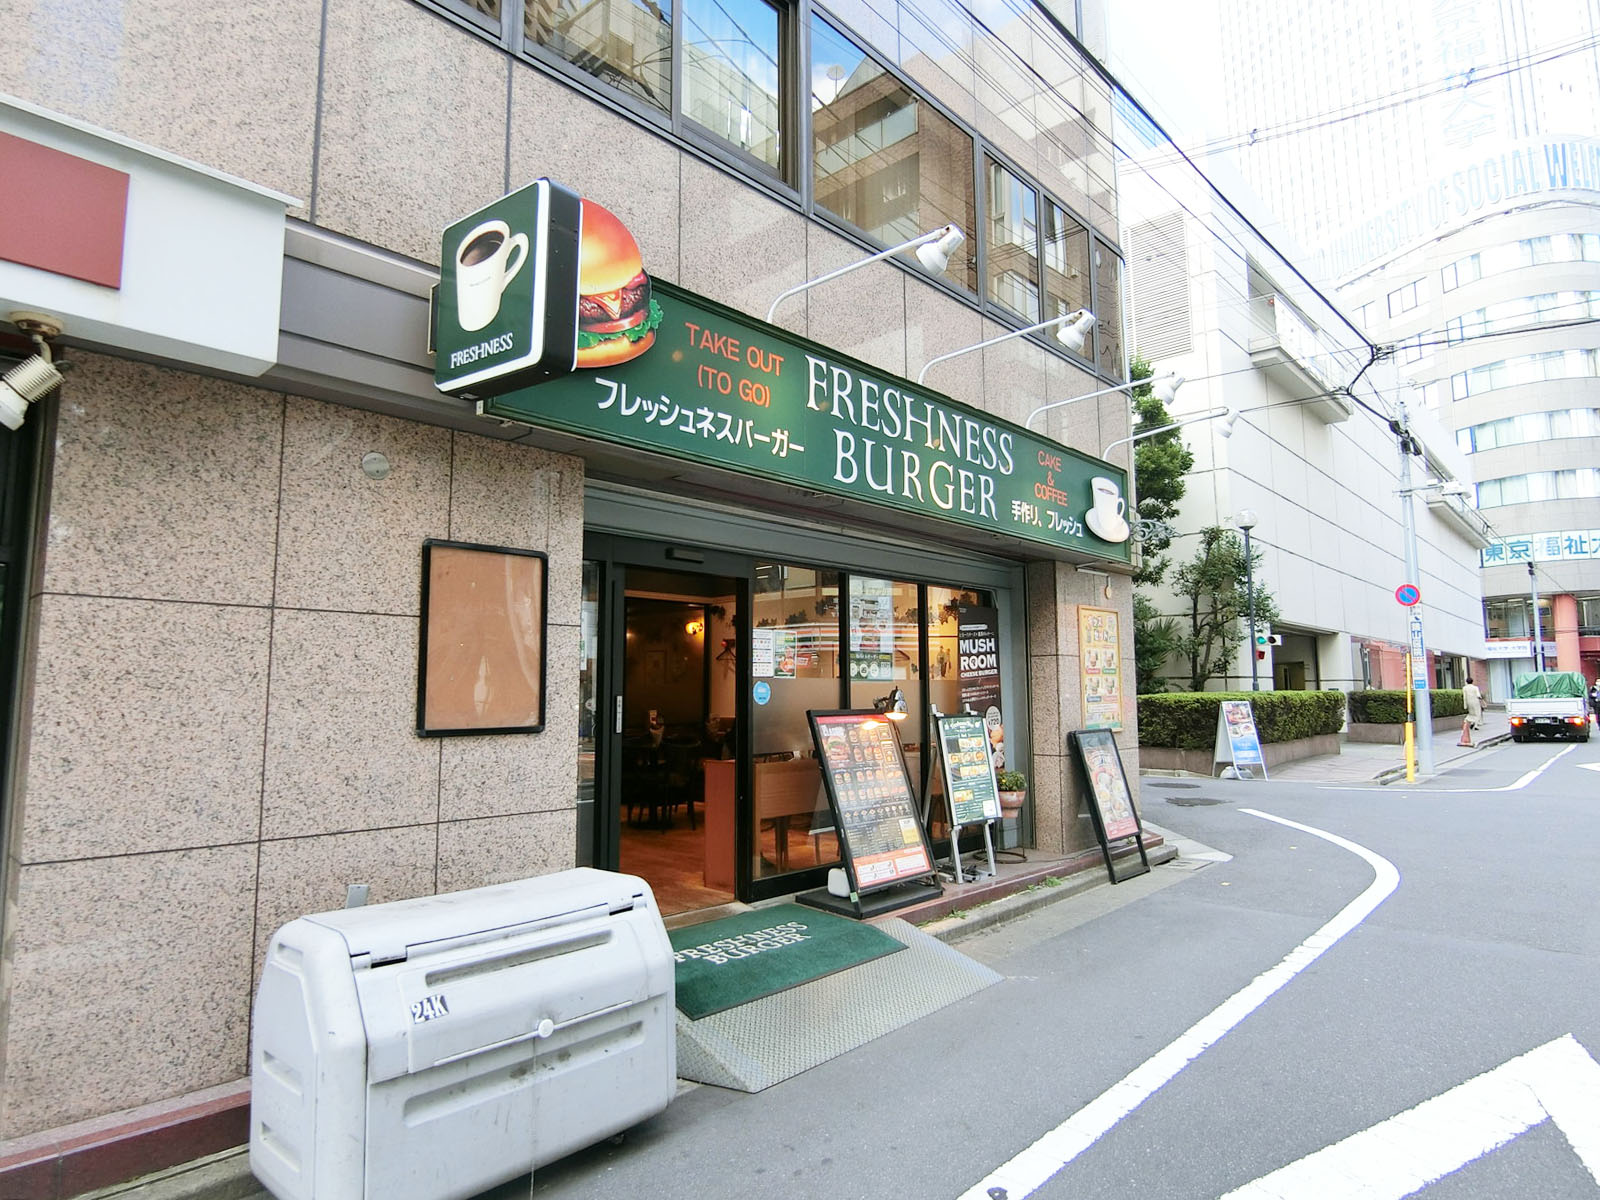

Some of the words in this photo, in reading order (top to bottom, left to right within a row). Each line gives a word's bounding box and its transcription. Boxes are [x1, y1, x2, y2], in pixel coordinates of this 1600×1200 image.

[1427, 177, 1450, 230] OF
[1452, 146, 1540, 217] SOCIAL
[450, 332, 513, 369] FRESHNESS
[685, 322, 740, 361] TAKE
[746, 346, 784, 376] OUT
[697, 365, 732, 395] (TO
[739, 382, 771, 408] GO)
[595, 377, 804, 457] フレッシュネスバーガー
[804, 354, 1013, 475] FRESHNESS
[833, 428, 998, 521] BURGER
[1038, 451, 1061, 472] CAKE
[1047, 471, 1054, 486] &
[1035, 483, 1067, 506] COFFEE
[960, 638, 995, 654] MUSH
[961, 654, 997, 671] ROOM
[673, 921, 808, 963] FRESHNESS
[702, 932, 812, 965] BURGER
[410, 995, 449, 1024] 24K
